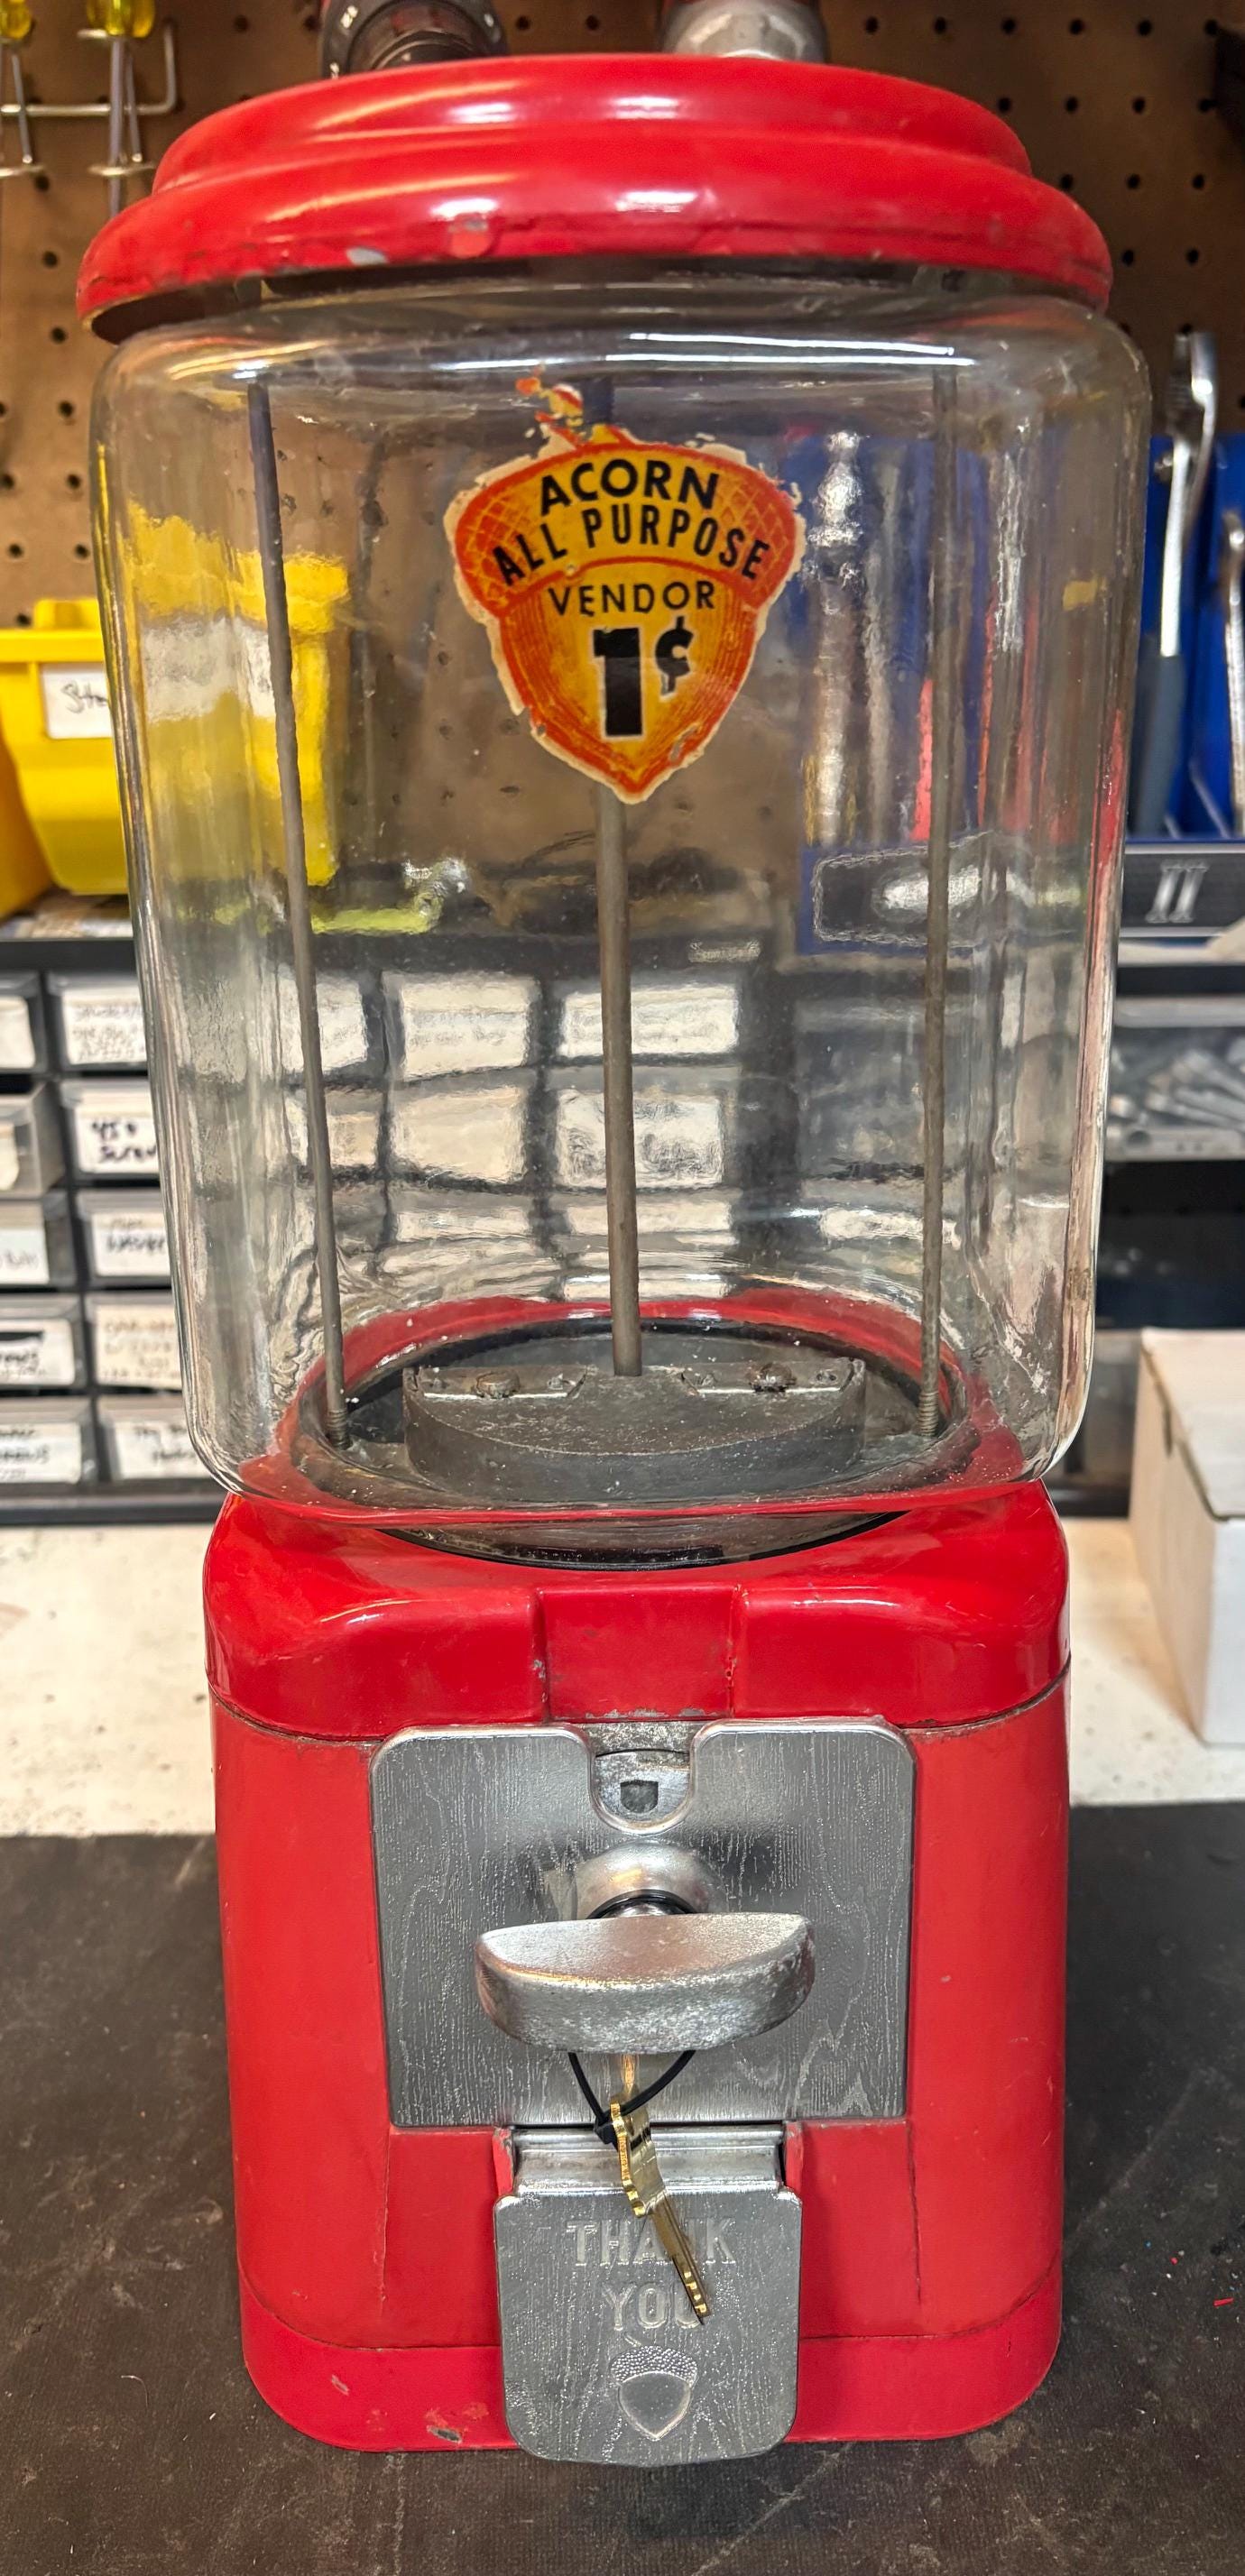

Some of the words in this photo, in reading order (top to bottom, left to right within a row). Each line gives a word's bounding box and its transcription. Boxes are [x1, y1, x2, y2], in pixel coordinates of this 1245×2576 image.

[540, 458, 719, 516] ACORN
[492, 522, 568, 586] ALL
[585, 502, 770, 581] PURPOSE
[549, 581, 715, 617] VENDOR
